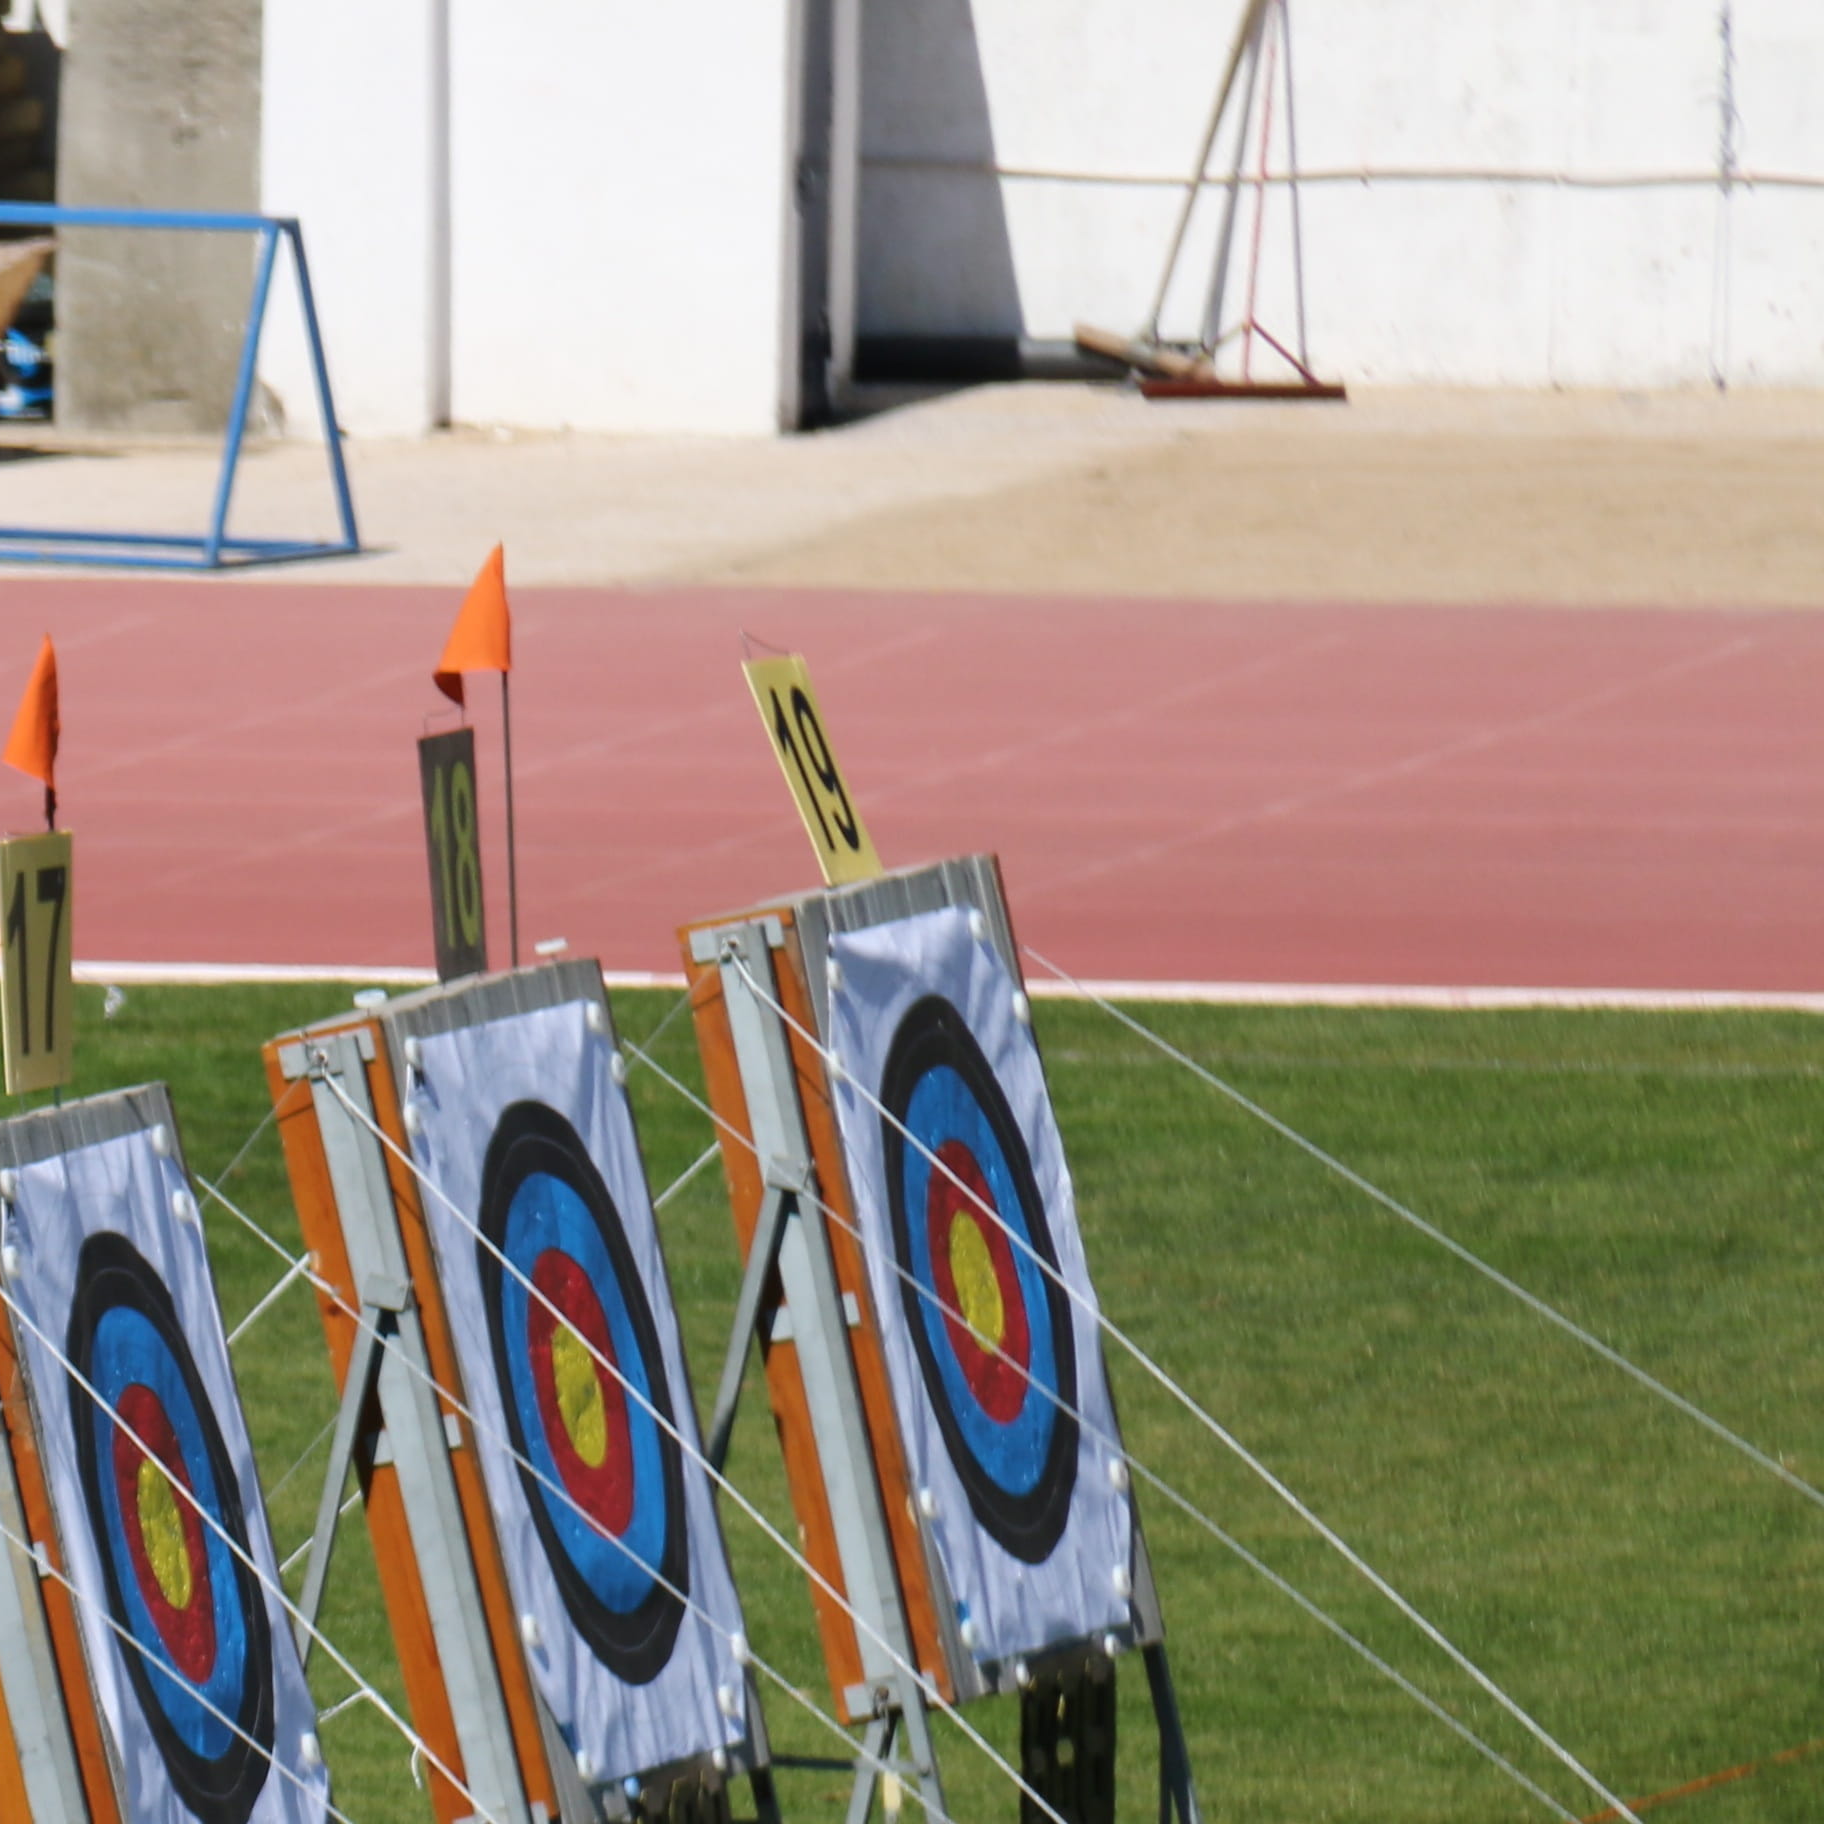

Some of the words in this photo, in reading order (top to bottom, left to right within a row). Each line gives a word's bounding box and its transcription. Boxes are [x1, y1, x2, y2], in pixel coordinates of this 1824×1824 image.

[429, 759, 480, 947] 18
[770, 684, 861, 852] 19
[4, 864, 66, 1056] 17
